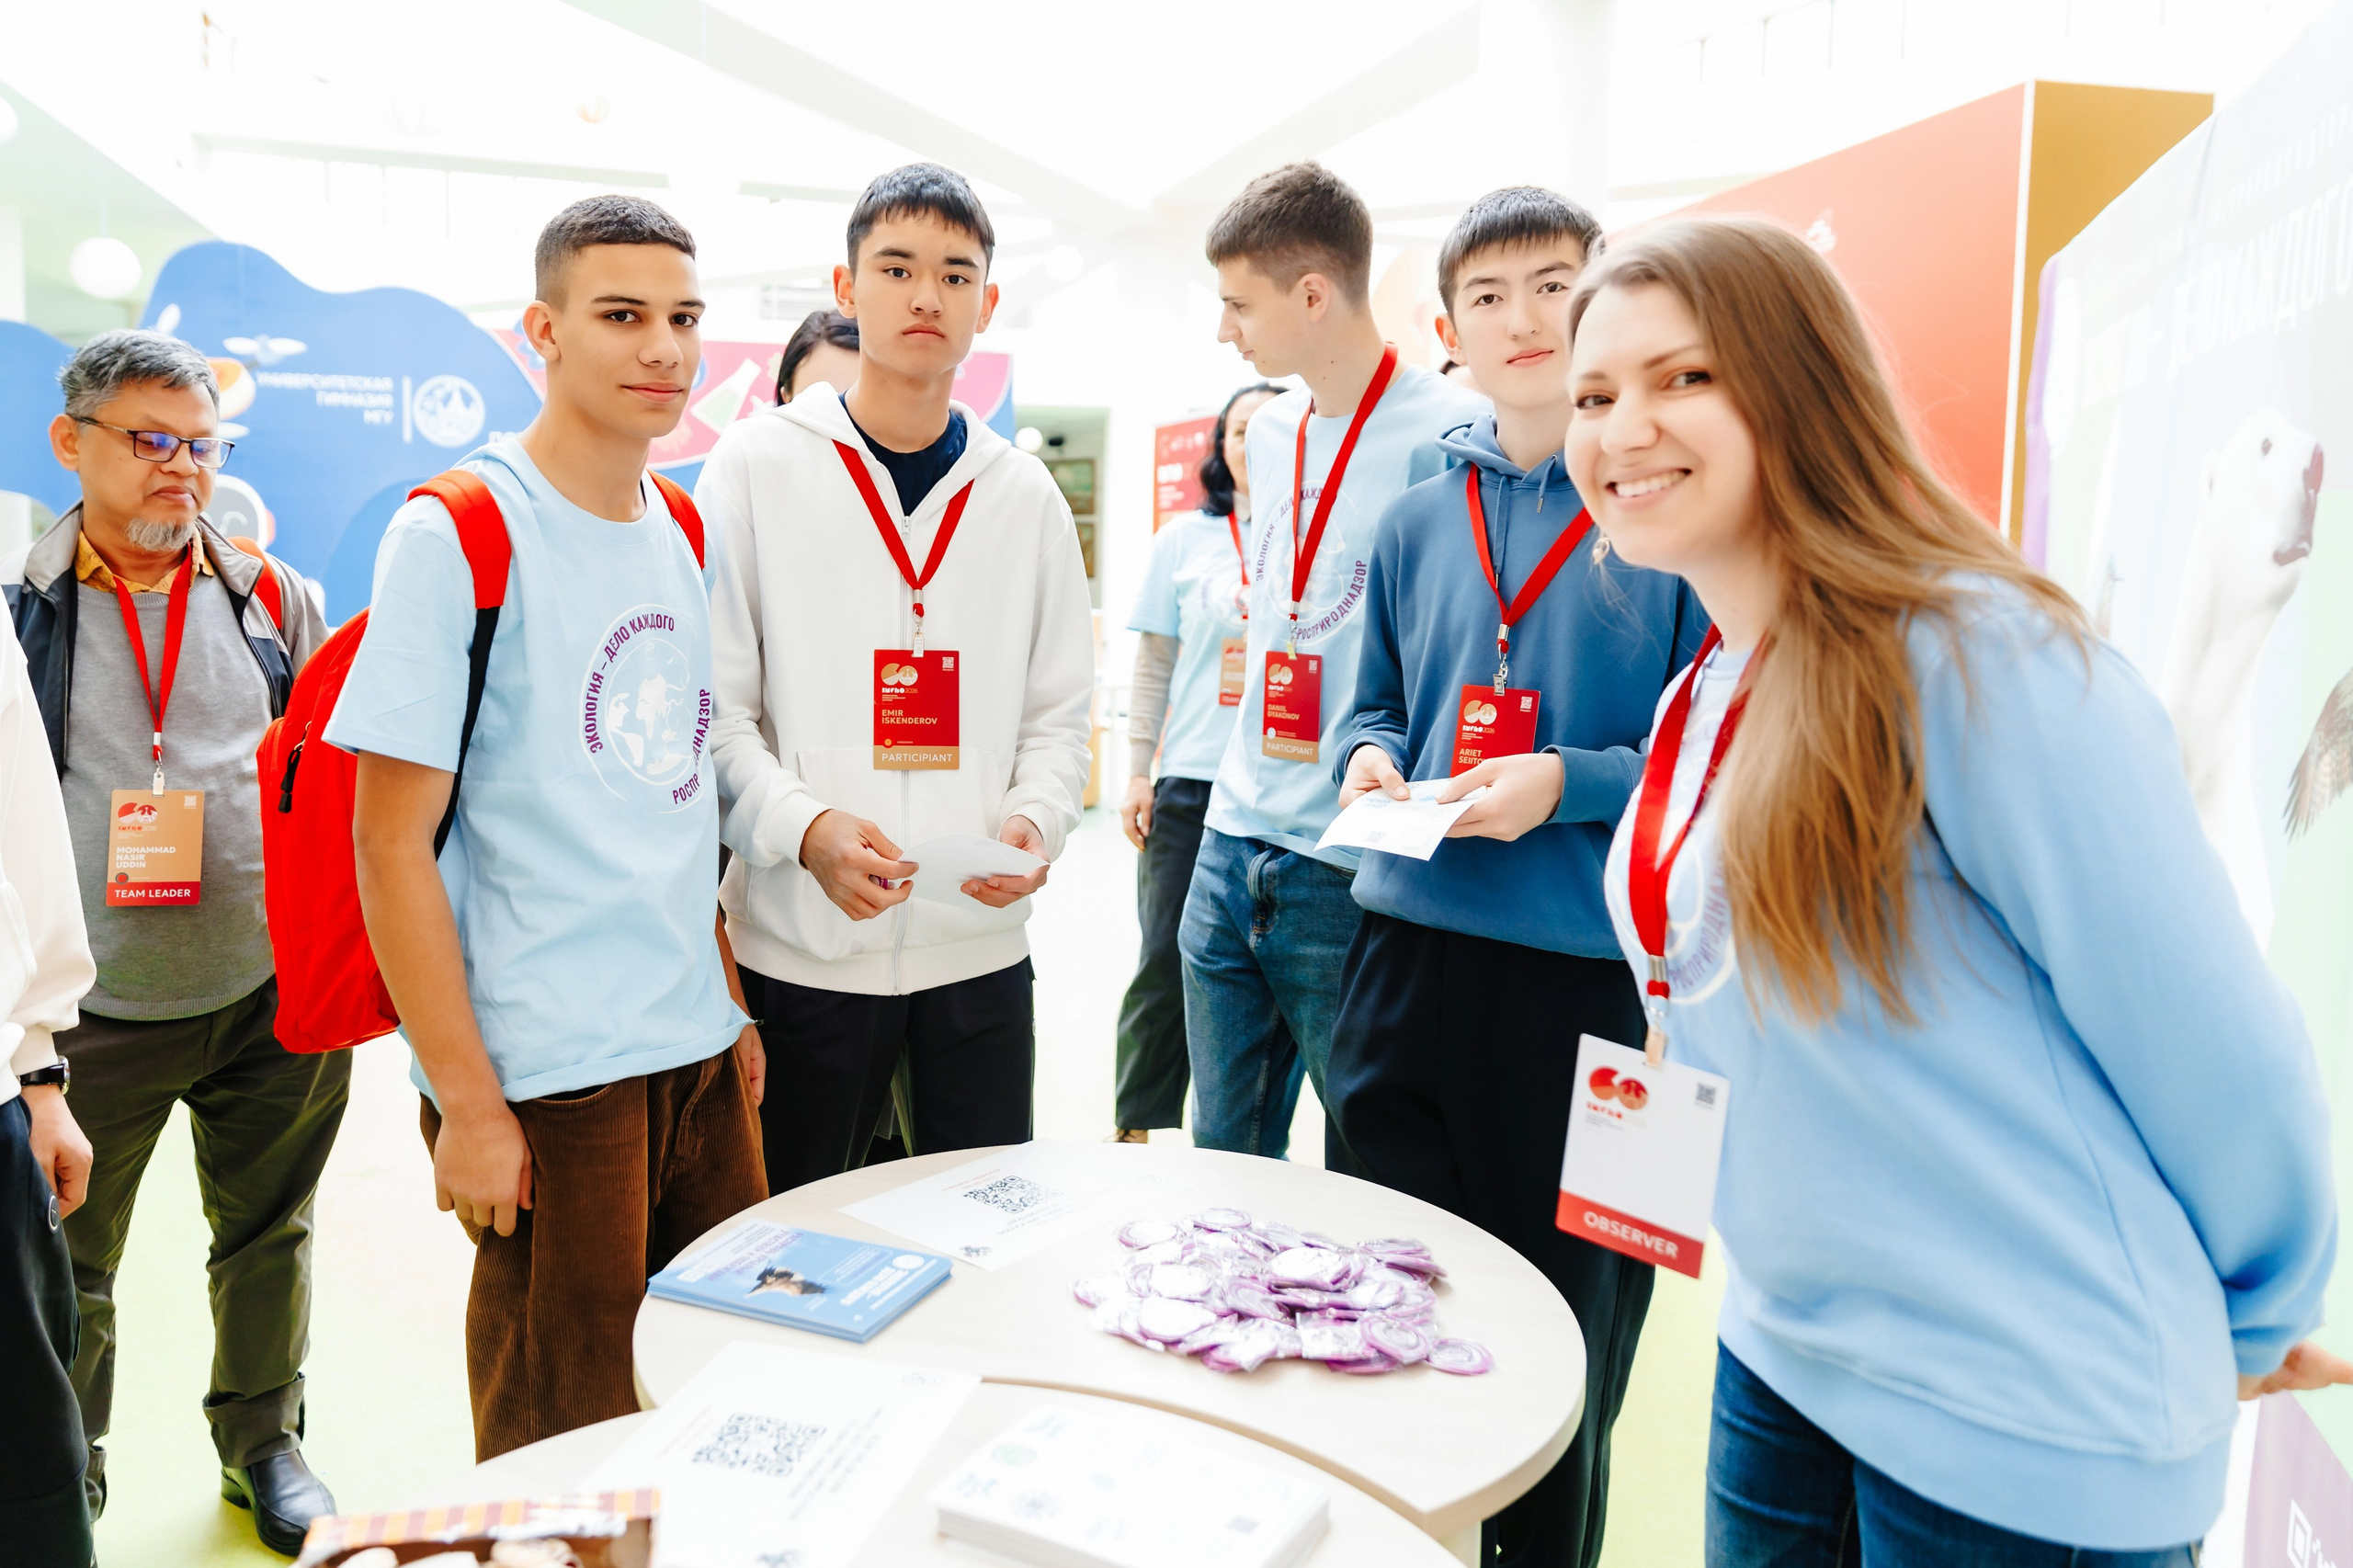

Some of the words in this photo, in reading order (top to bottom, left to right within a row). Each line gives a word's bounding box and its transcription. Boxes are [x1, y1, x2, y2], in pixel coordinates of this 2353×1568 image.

[256, 371, 393, 392] УНИВЕРСИТЕТСКАЯ
[315, 391, 393, 408] ГИМНАЗИЯ
[363, 409, 393, 425] МГУ
[1256, 525, 1275, 582] ЭКОЛОГИЯ
[1296, 560, 1368, 640] РОСПРИРОДНАДЗОР
[585, 672, 605, 754] ЭКОЛОГИЯ
[604, 625, 631, 664] ДЕЛО
[629, 613, 675, 635] КАЖДОГО
[881, 717, 938, 725] ISKENDEROV
[1267, 710, 1300, 721] DYAKONOV
[672, 688, 710, 805] РОСПРДНАДЗОР
[1267, 742, 1314, 756] PARTICIPIANT
[1460, 747, 1482, 756] ARIET
[881, 754, 953, 762] PARTICIPIANT
[1459, 756, 1483, 765] SEIITO
[115, 890, 145, 898] TEAM
[149, 889, 191, 897] LEADER
[1584, 1210, 1679, 1258] OBSERVER
